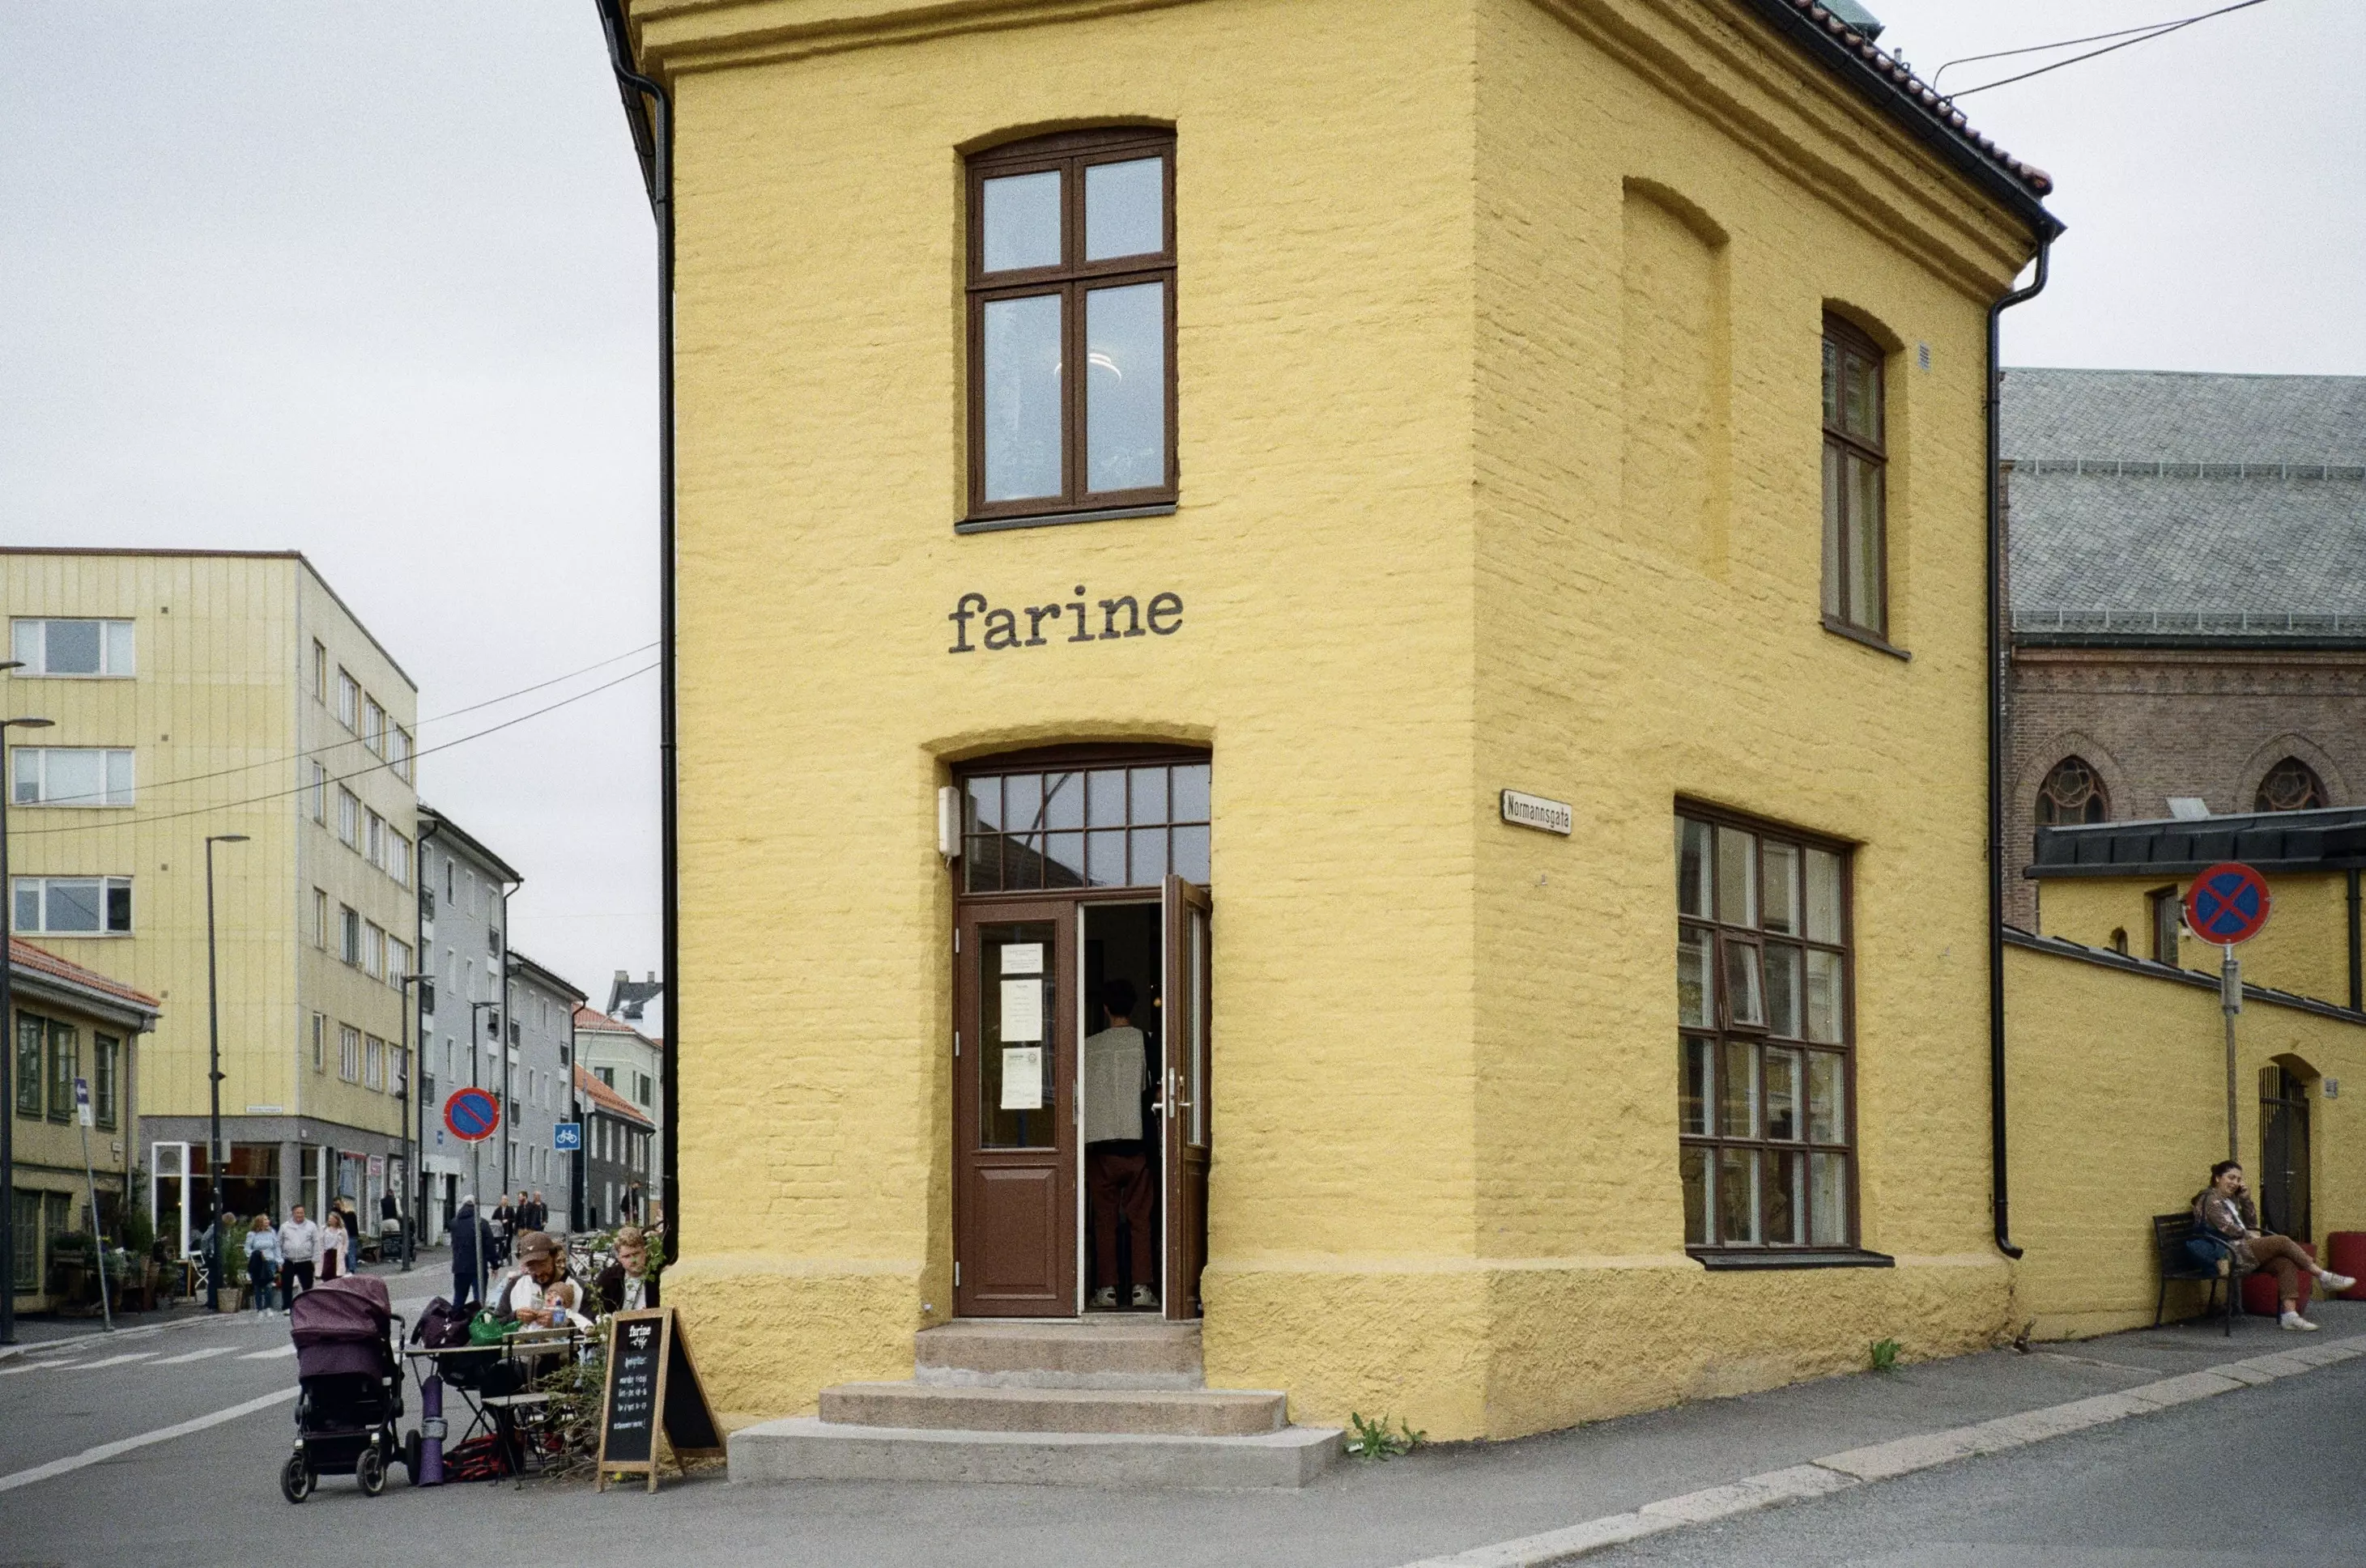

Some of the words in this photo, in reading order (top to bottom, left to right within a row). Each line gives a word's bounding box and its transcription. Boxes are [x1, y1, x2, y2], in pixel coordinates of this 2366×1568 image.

[948, 584, 1184, 653] farine
[1508, 795, 1569, 828] Normannsgata
[628, 1324, 651, 1337] farine
